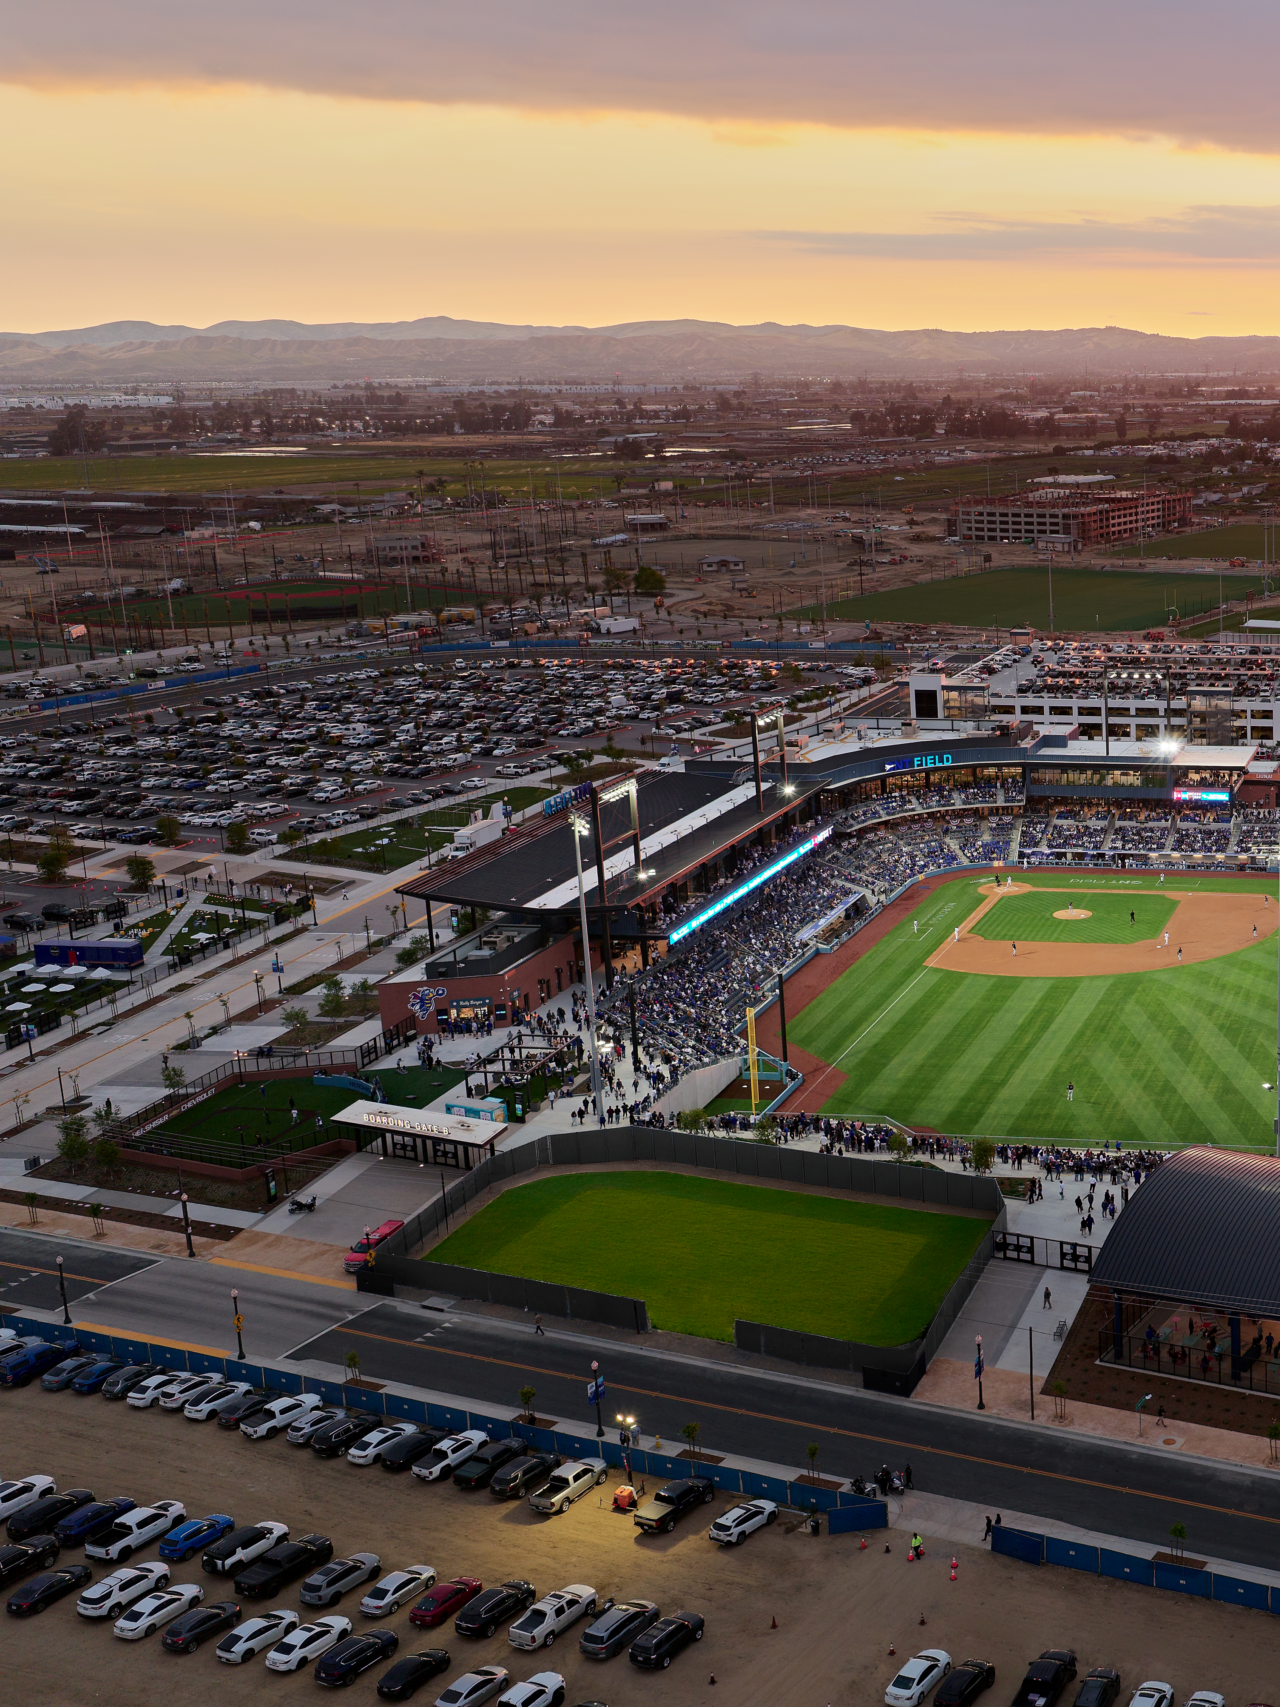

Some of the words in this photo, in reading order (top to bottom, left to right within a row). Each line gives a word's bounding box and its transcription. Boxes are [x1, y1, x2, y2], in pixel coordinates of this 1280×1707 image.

[914, 754, 952, 768] FIELD
[181, 1087, 216, 1112] CHEVROLET
[363, 1113, 411, 1129] BOARDING
[415, 1122, 439, 1134] GATE
[442, 1126, 450, 1135] B
